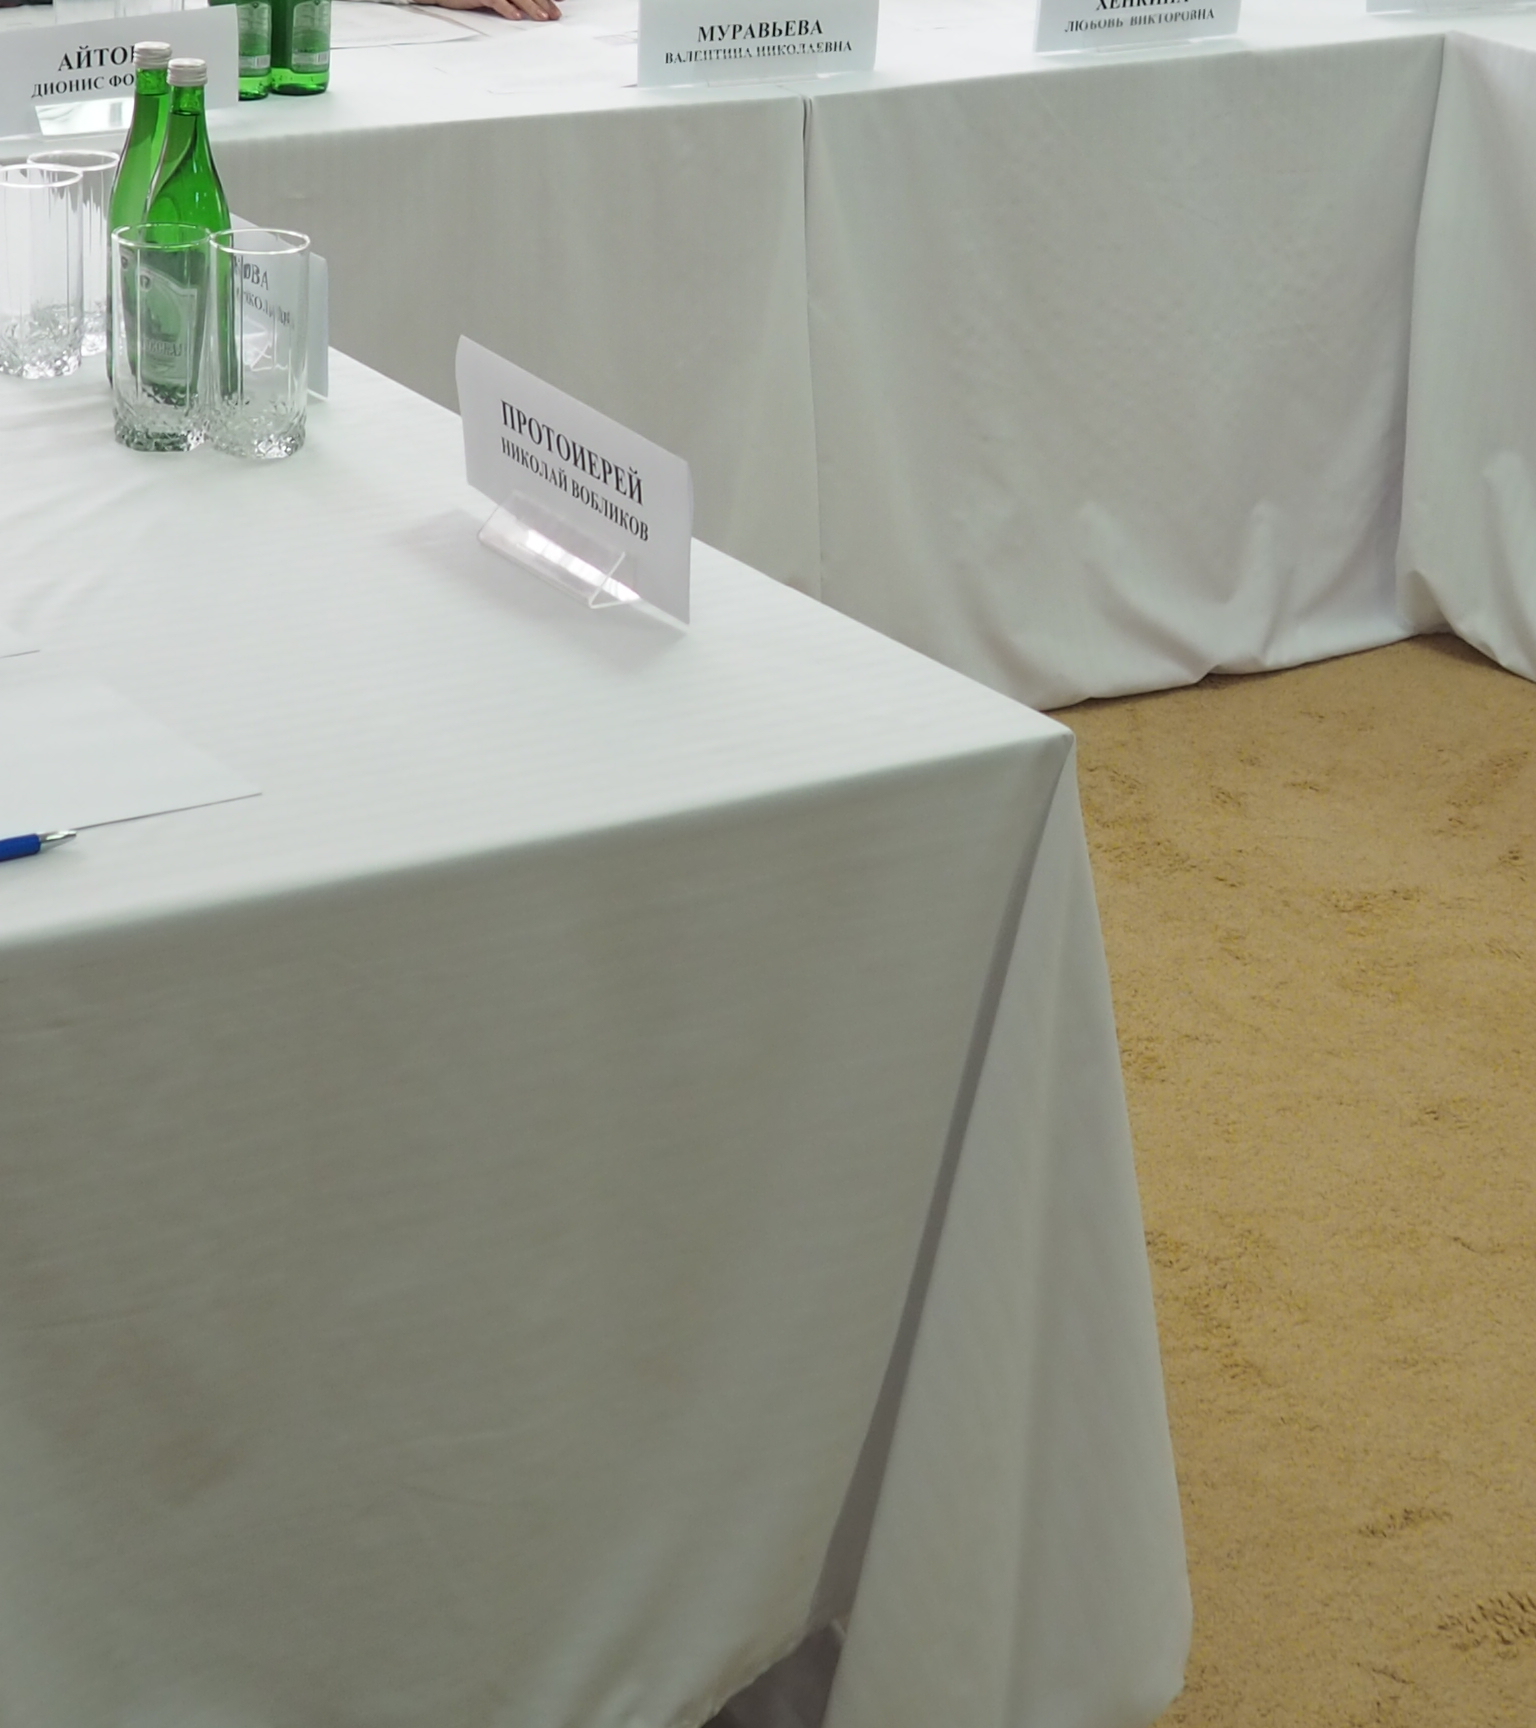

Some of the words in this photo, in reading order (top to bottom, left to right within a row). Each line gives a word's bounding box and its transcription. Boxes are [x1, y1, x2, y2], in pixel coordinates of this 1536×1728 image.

[697, 19, 824, 43] МУРАВЬЕВА
[1064, 17, 1124, 33] ЛЮБОВЬ
[1129, 8, 1215, 27] ВИКТОРОВНА
[58, 44, 135, 72] АЙТО
[664, 46, 753, 64] ВАЛЕНТИНА
[756, 40, 853, 58] НИКОЛАЕВНА
[31, 76, 105, 99] ДИОНИС
[500, 399, 644, 507] ПРОТОИЕРЕЙ
[501, 436, 568, 493] НИКОЛАЙ
[571, 483, 650, 542] ВОБЛИКОВ
